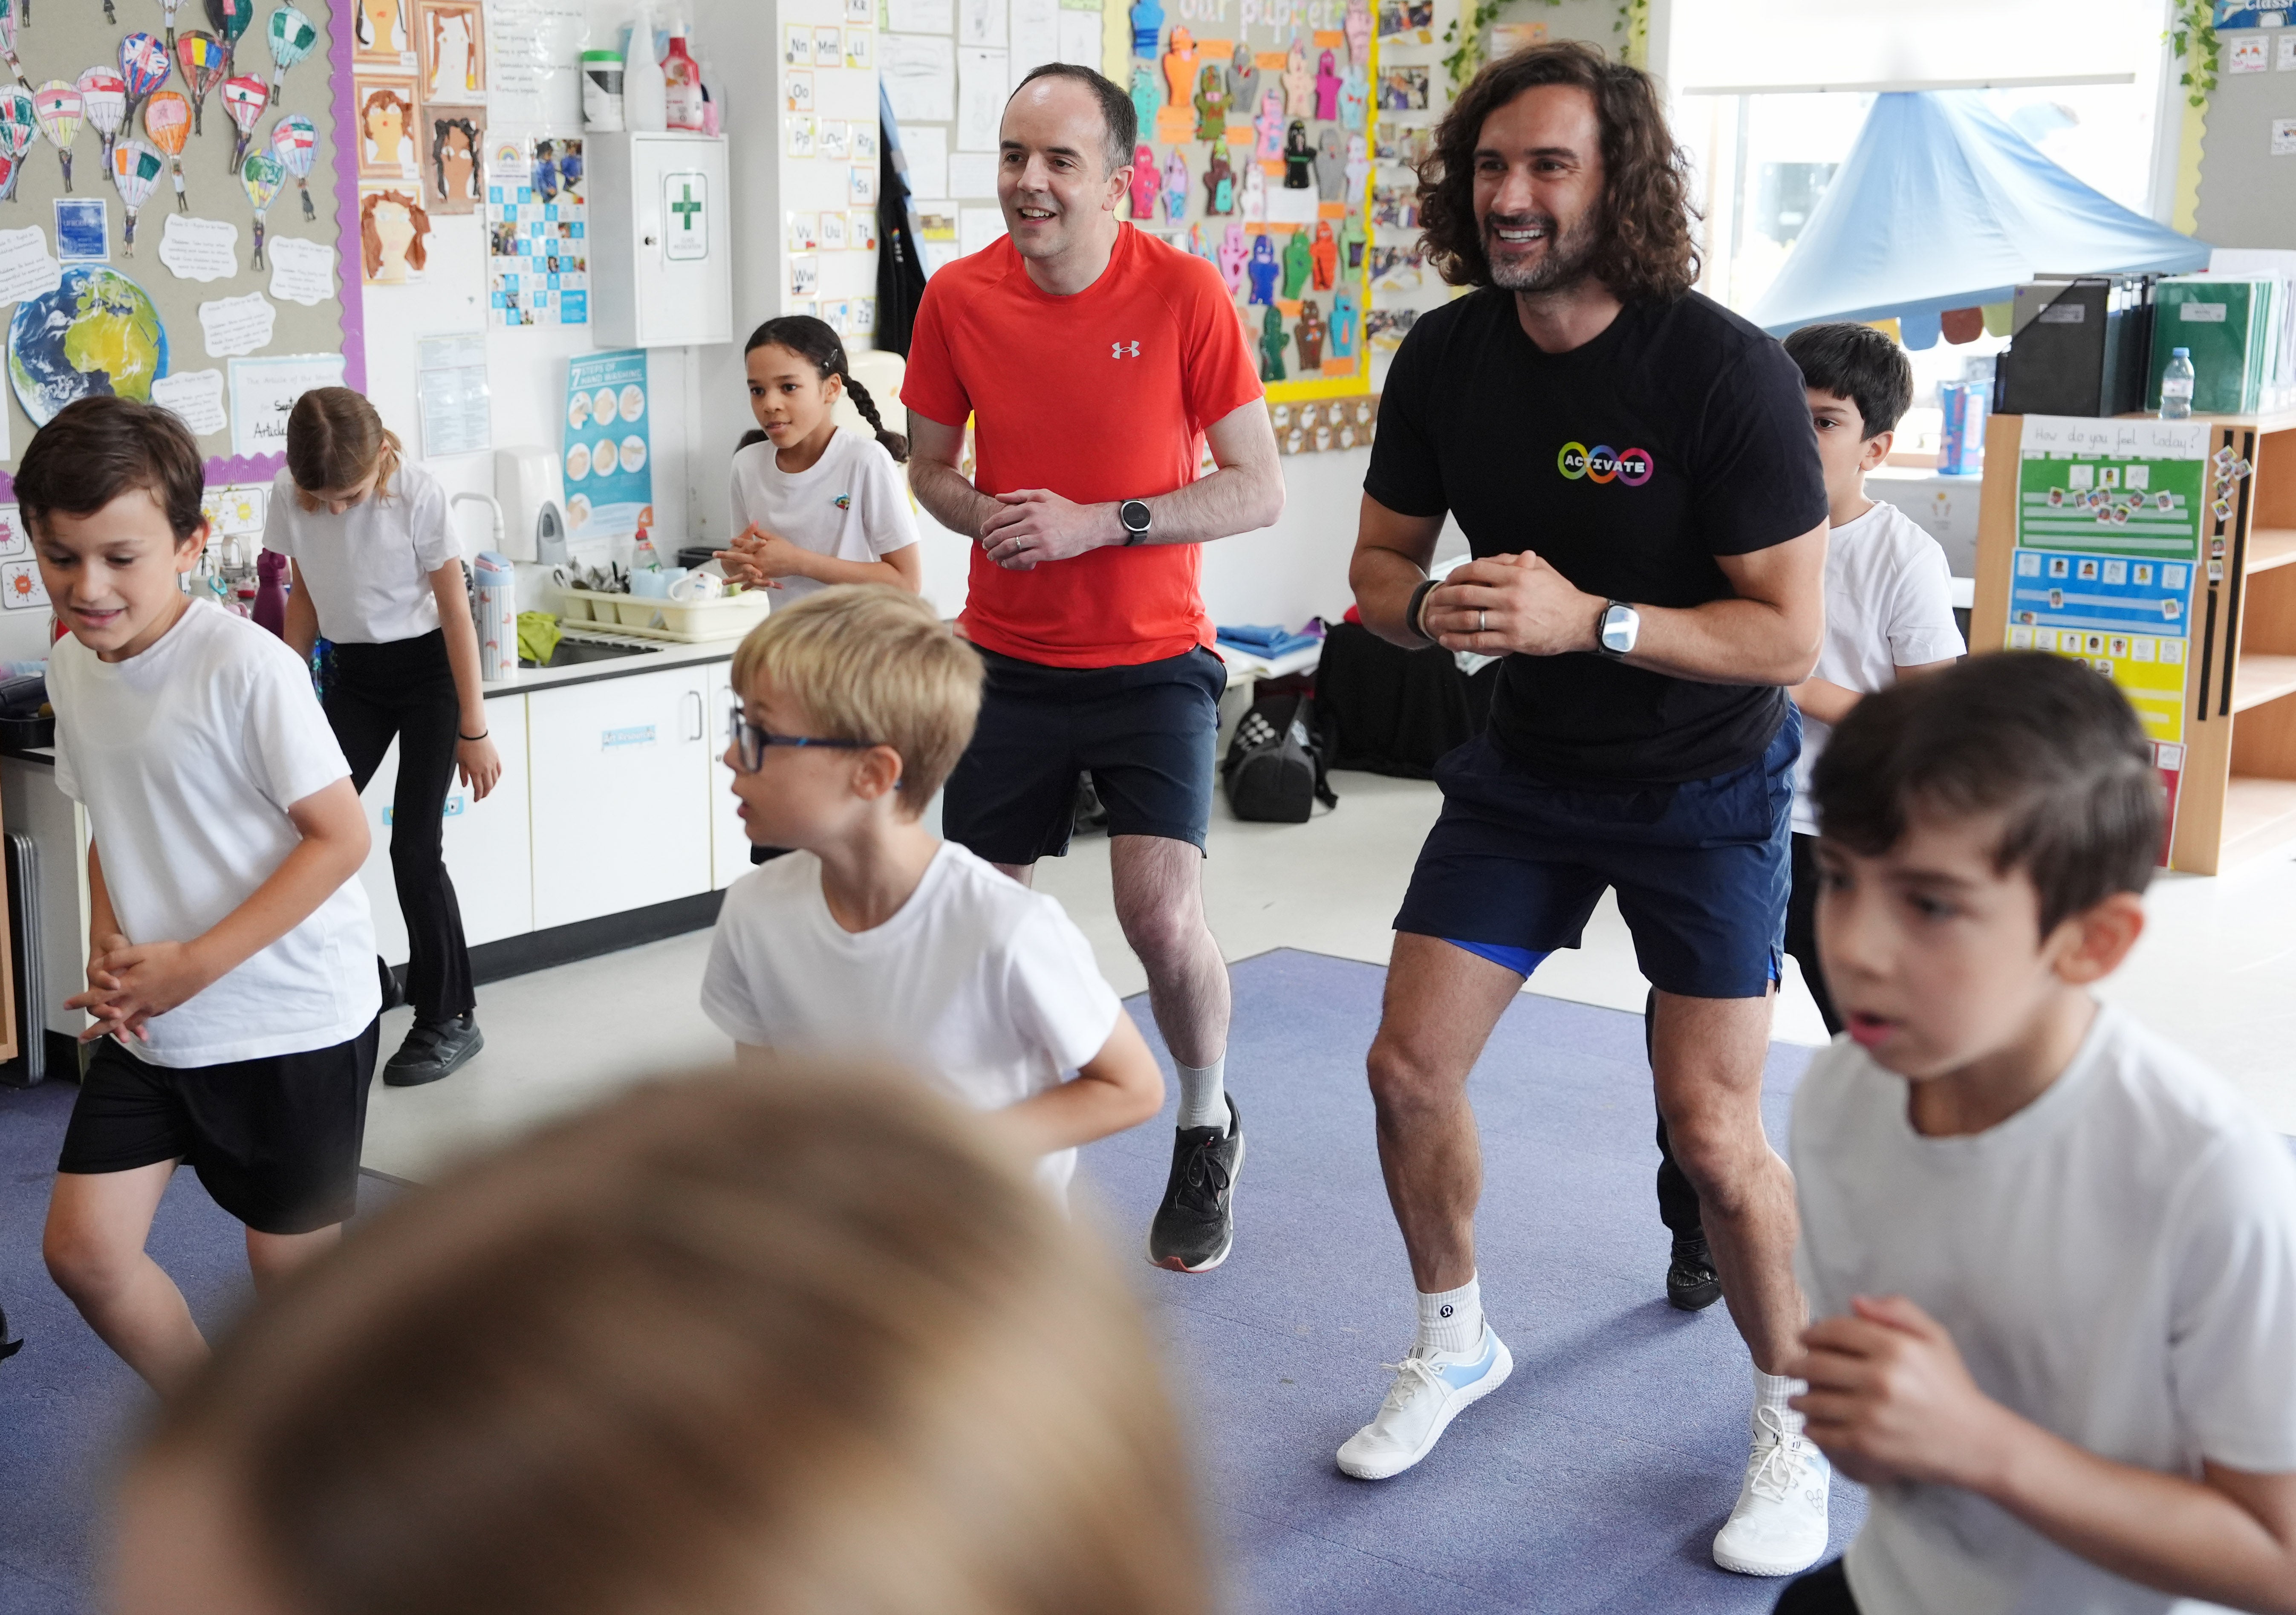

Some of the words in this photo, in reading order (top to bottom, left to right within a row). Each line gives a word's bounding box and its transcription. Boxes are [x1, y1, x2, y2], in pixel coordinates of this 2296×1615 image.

[791, 38, 807, 53] Nn
[817, 40, 838, 55] Mm
[793, 83, 809, 98] Oo
[795, 130, 810, 150] Pp
[857, 133, 871, 147] Rr
[856, 179, 869, 194] Ss
[796, 225, 812, 239] Vv
[824, 224, 840, 238] Uu
[858, 224, 868, 238] Tt
[793, 269, 816, 282] Ww
[858, 309, 870, 324] Zz
[571, 367, 581, 387] 7
[2036, 427, 2058, 442] How
[2068, 425, 2084, 443] do
[2089, 434, 2108, 450] you
[2114, 426, 2137, 453] feel
[2152, 425, 2201, 459] today?
[1565, 454, 1646, 474] ACTIVATE
